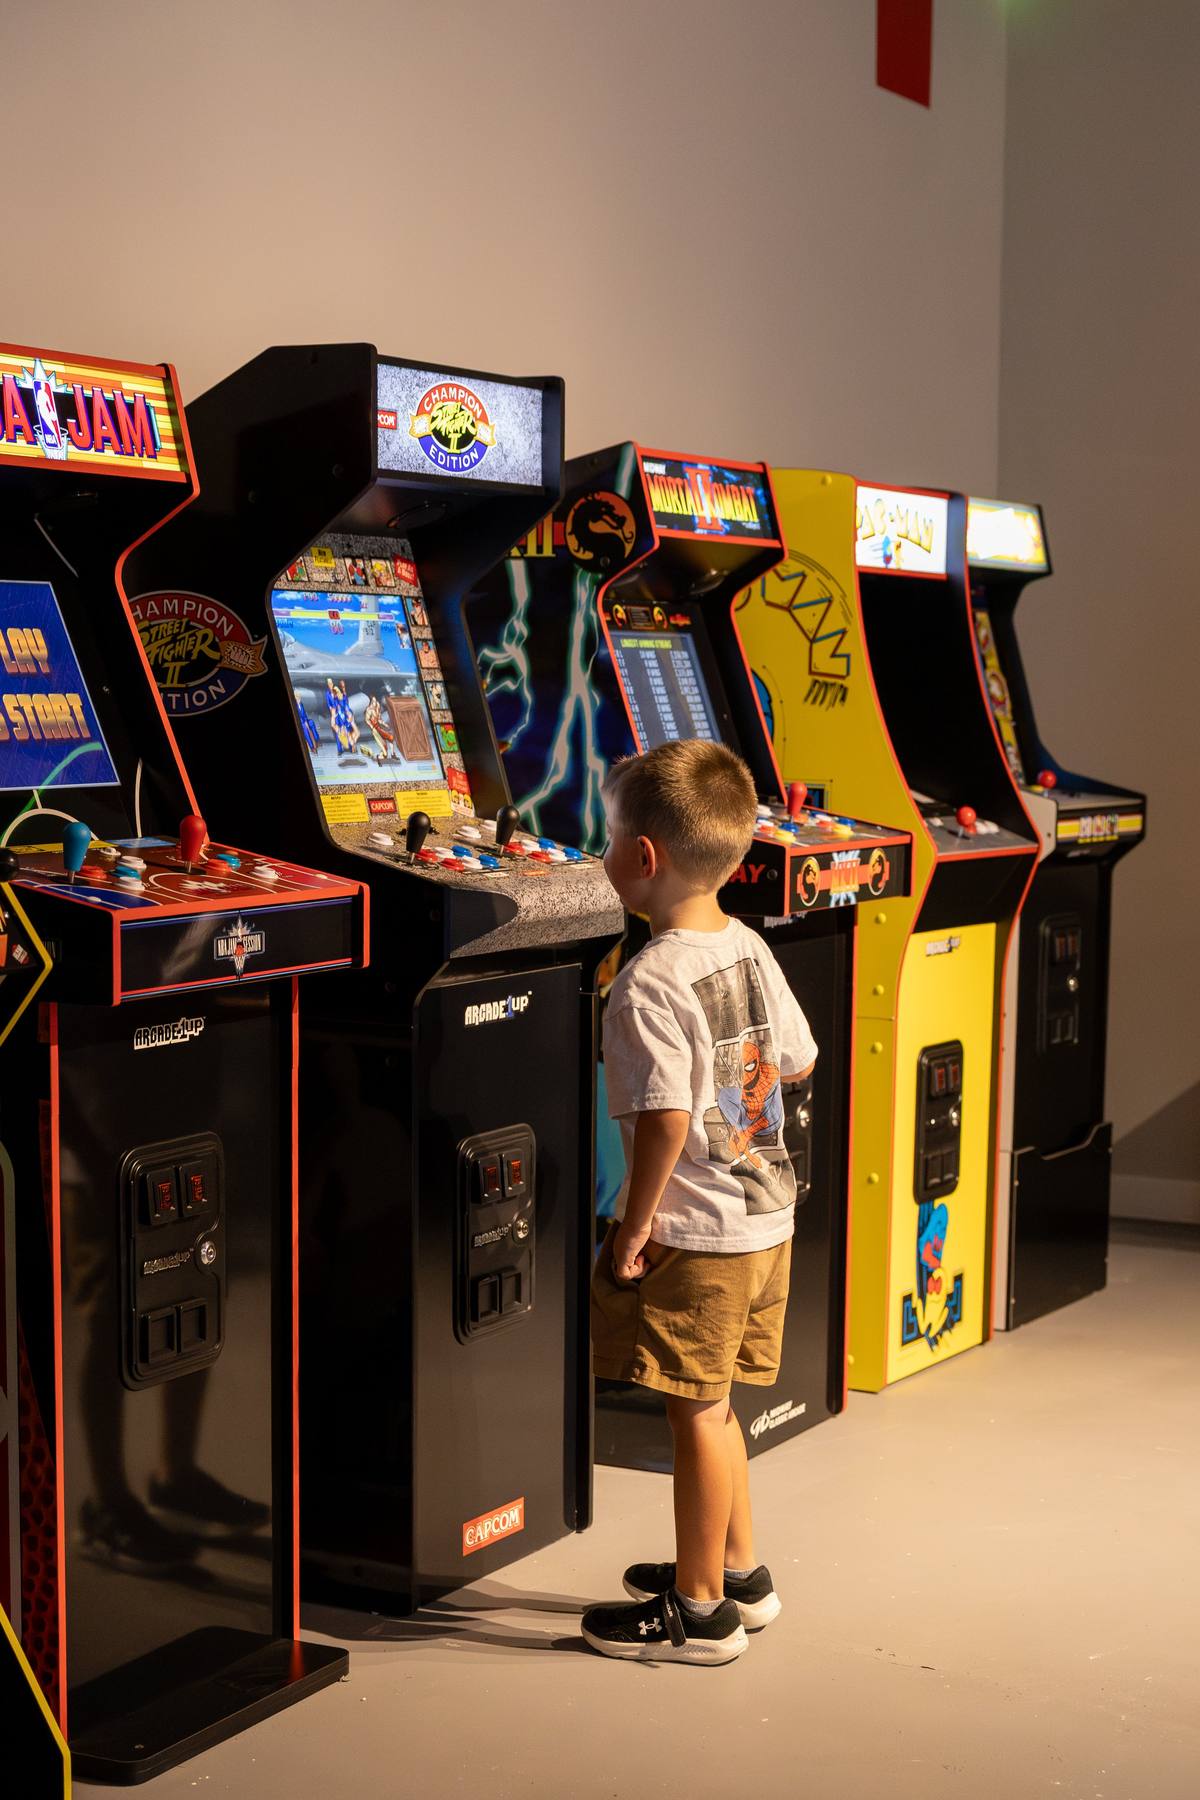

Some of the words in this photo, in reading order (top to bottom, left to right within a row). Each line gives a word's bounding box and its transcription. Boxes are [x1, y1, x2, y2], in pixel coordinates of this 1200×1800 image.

[66, 384, 158, 459] JAM
[423, 387, 483, 419] CHAMPION
[429, 444, 480, 470] EDITION
[0, 627, 50, 674] LAY
[2, 693, 91, 740] START
[465, 1504, 522, 1548] CAPCOM
